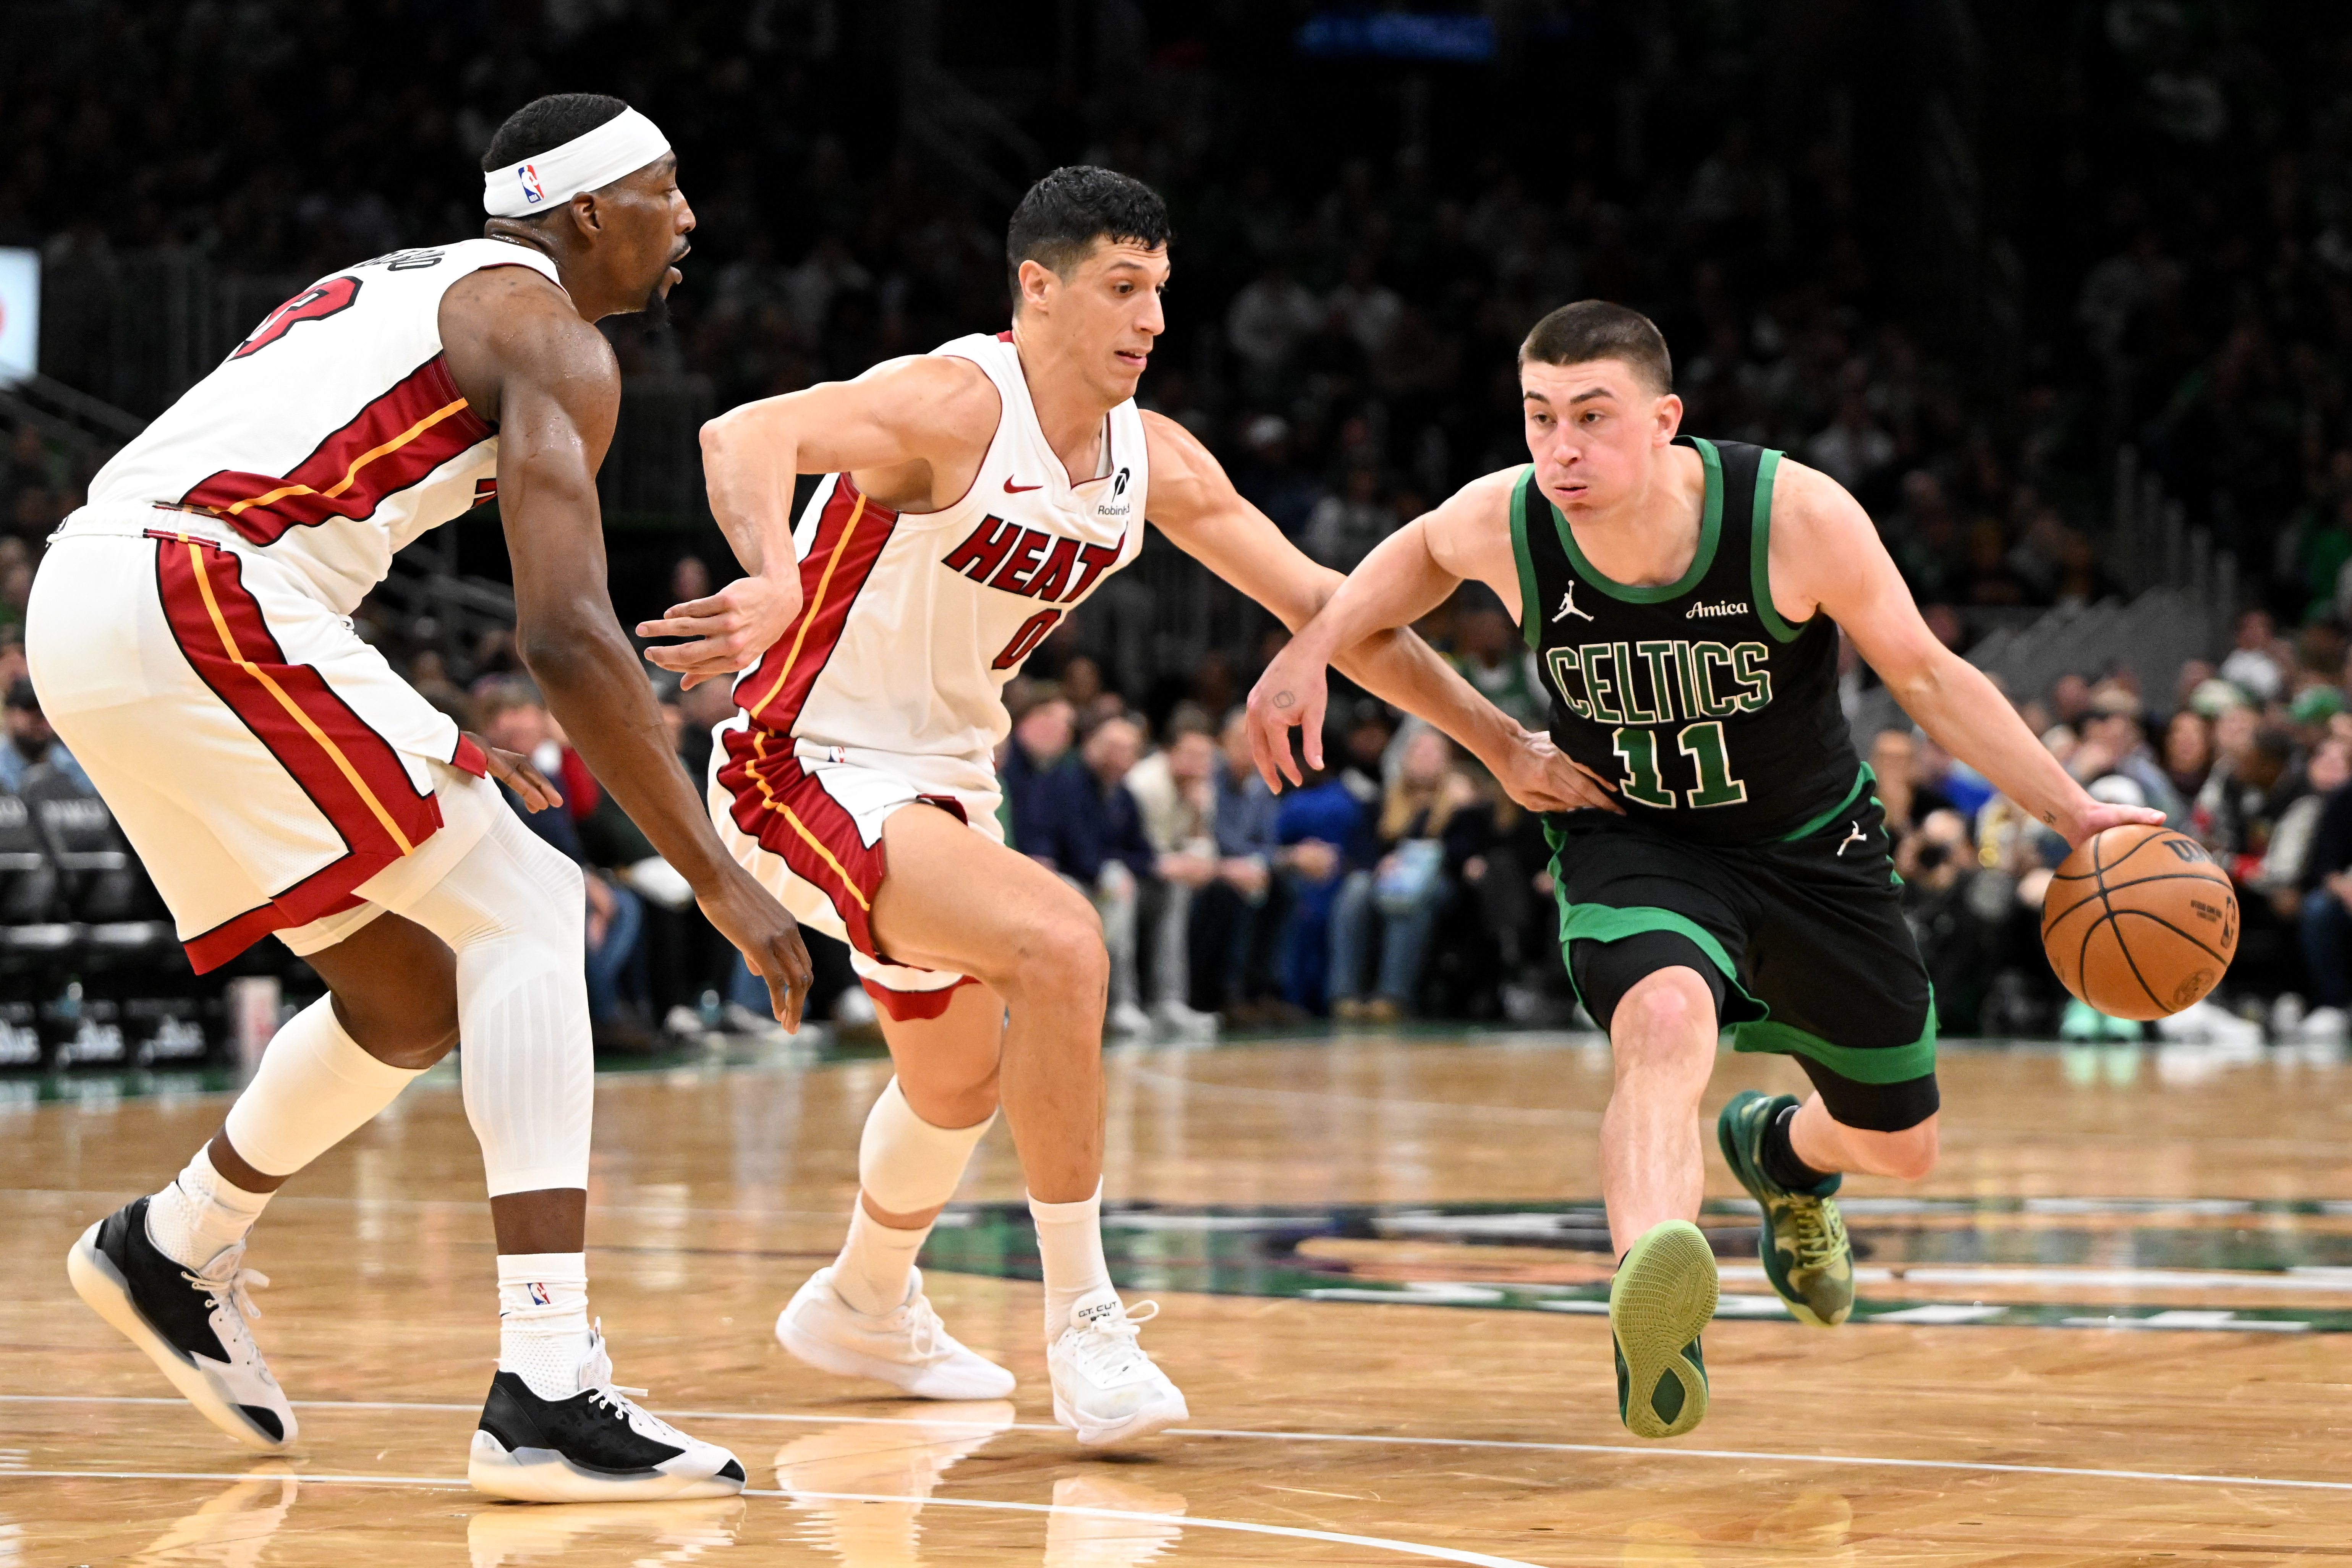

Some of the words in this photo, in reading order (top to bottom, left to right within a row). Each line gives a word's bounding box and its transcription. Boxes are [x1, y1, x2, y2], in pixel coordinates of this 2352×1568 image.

[940, 514, 1128, 602] HEAT
[991, 608, 1062, 670] 0
[1686, 600, 1748, 619] Amica
[1546, 641, 1772, 724] CELTICS
[1613, 721, 1747, 809] 11
[1097, 1301, 1117, 1312] CUT
